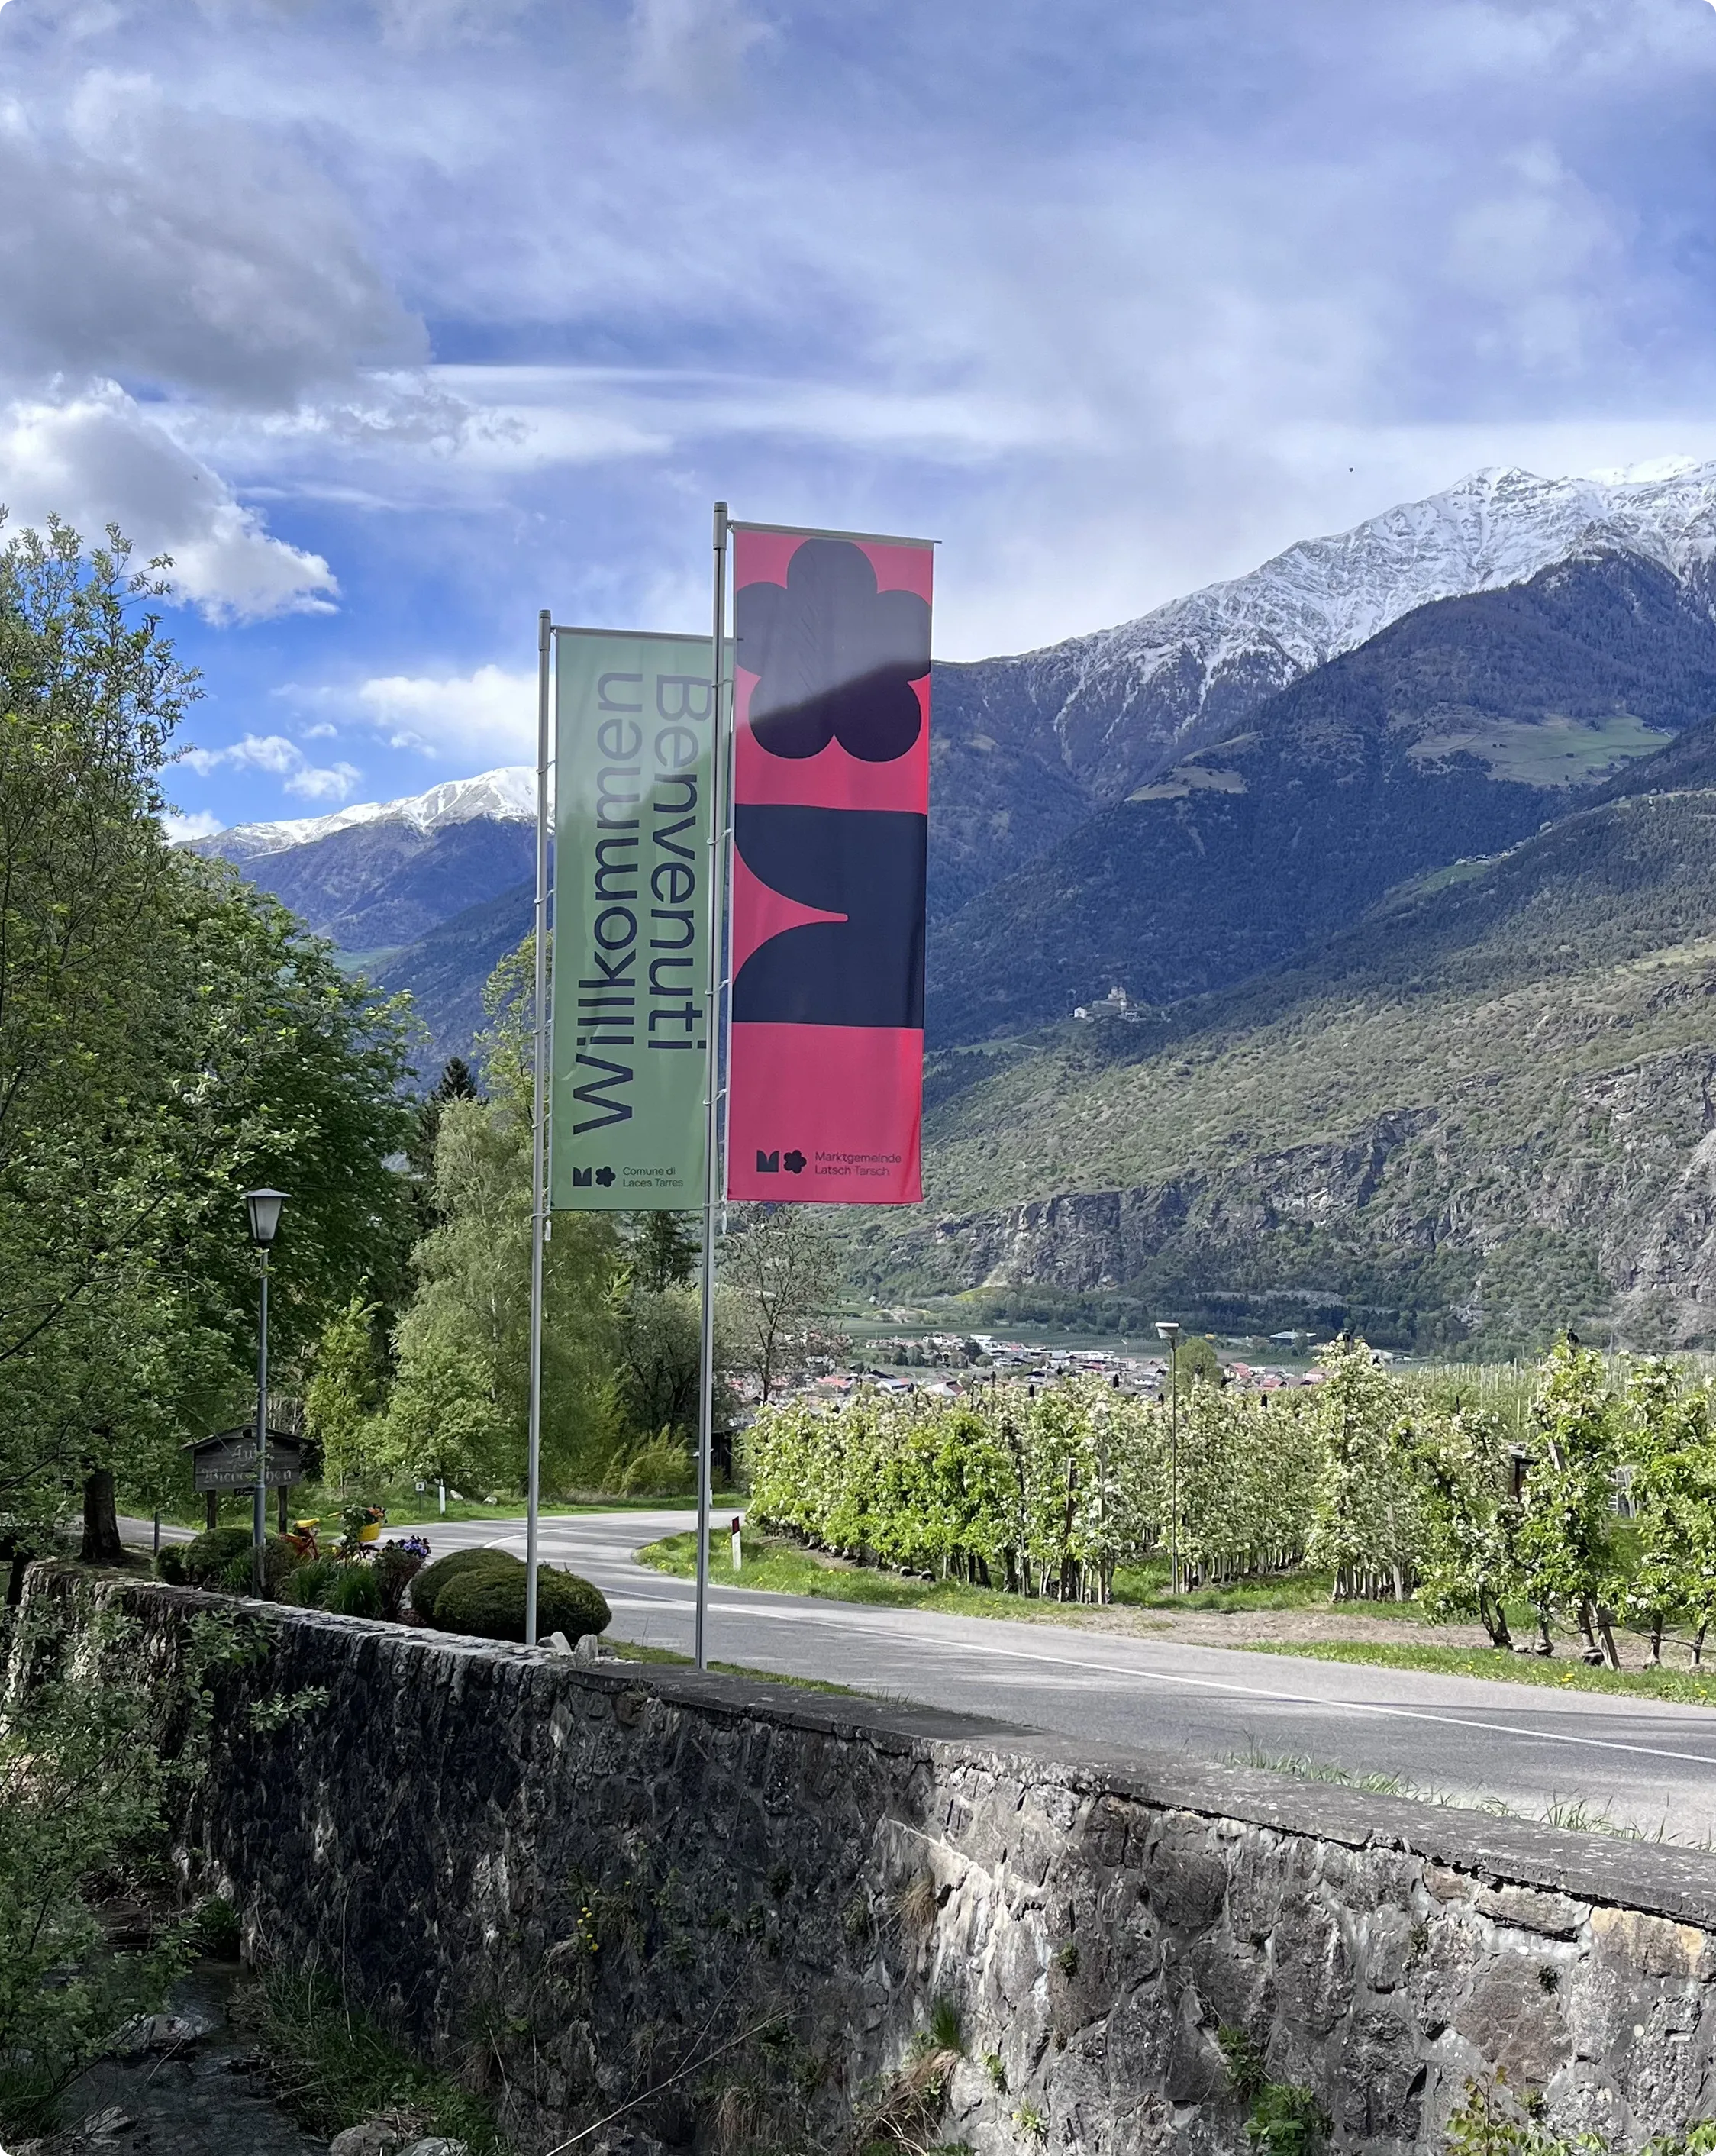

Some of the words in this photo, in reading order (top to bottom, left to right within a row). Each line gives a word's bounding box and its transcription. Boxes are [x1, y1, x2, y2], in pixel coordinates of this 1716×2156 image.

[648, 674, 712, 1049] Benvenuti
[573, 672, 644, 1135] Willkommen
[814, 1151, 902, 1164] Marktgemeinde
[622, 1167, 664, 1176] Comune
[666, 1167, 676, 1176] di
[814, 1165, 851, 1175] Latsch
[854, 1166, 890, 1176] Tarsch
[622, 1178, 652, 1188] Laces
[654, 1178, 683, 1187] Tarres
